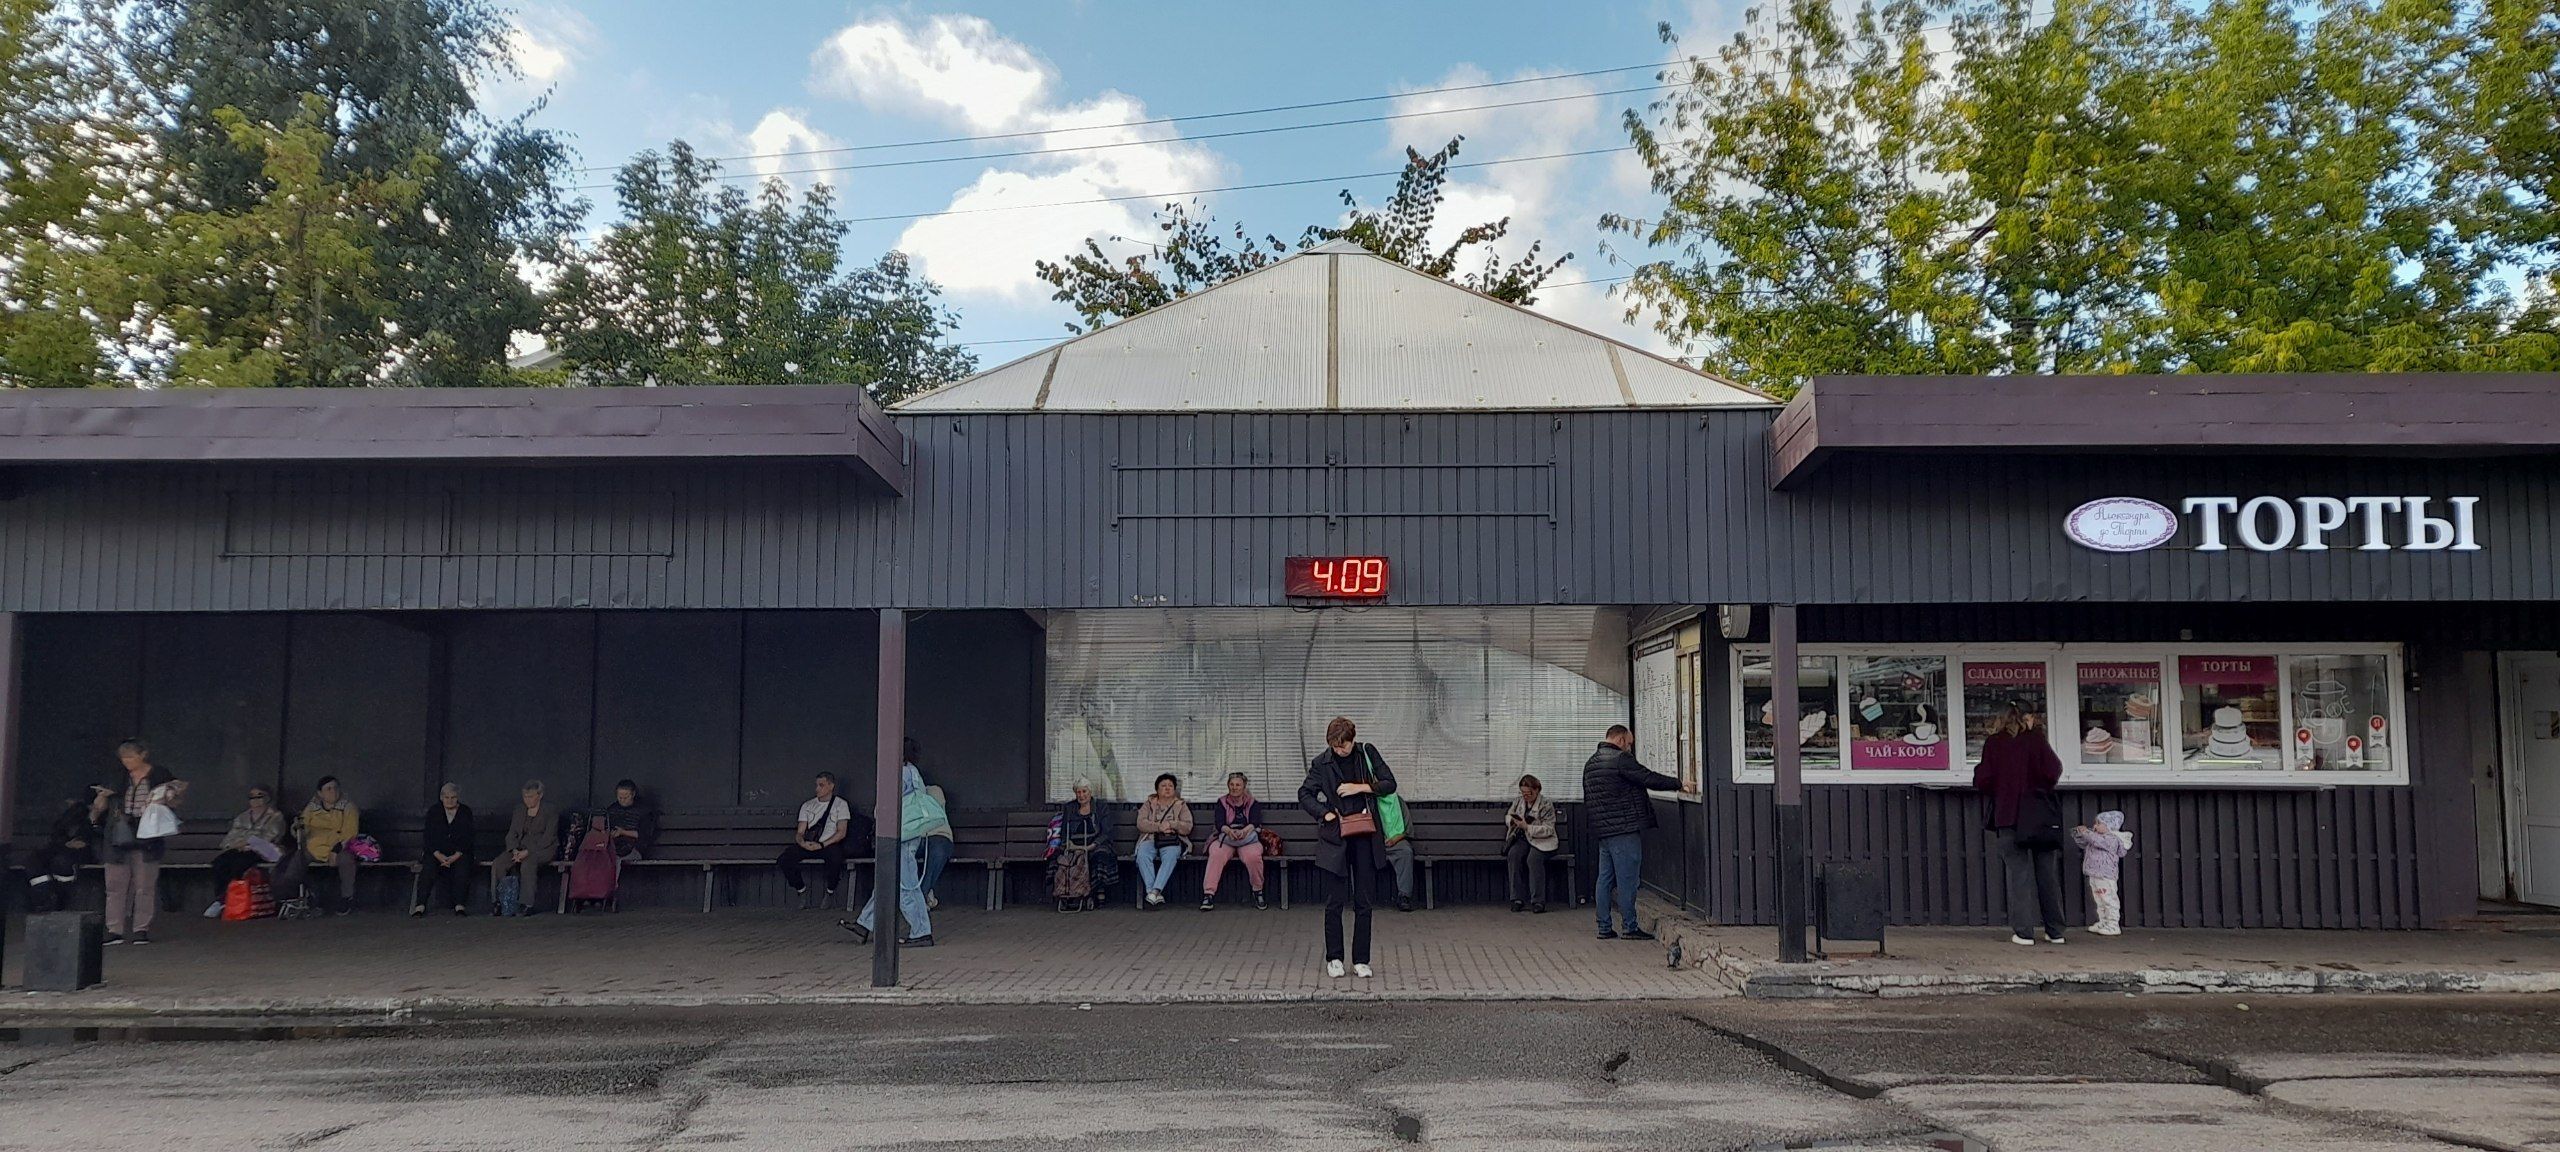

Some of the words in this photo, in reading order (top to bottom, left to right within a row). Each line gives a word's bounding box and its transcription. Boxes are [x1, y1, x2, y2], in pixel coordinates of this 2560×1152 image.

[2182, 496, 2481, 552] ТОРТЫ
[1313, 559, 1383, 593] 4.09
[1967, 667, 2042, 680] СЛАДОСТИ
[2079, 666, 2160, 680] ПИРОЖНЫЕ
[2200, 660, 2252, 673] ТОРТЫ
[1865, 744, 1936, 758] ЧАЙ-КОФЕ
